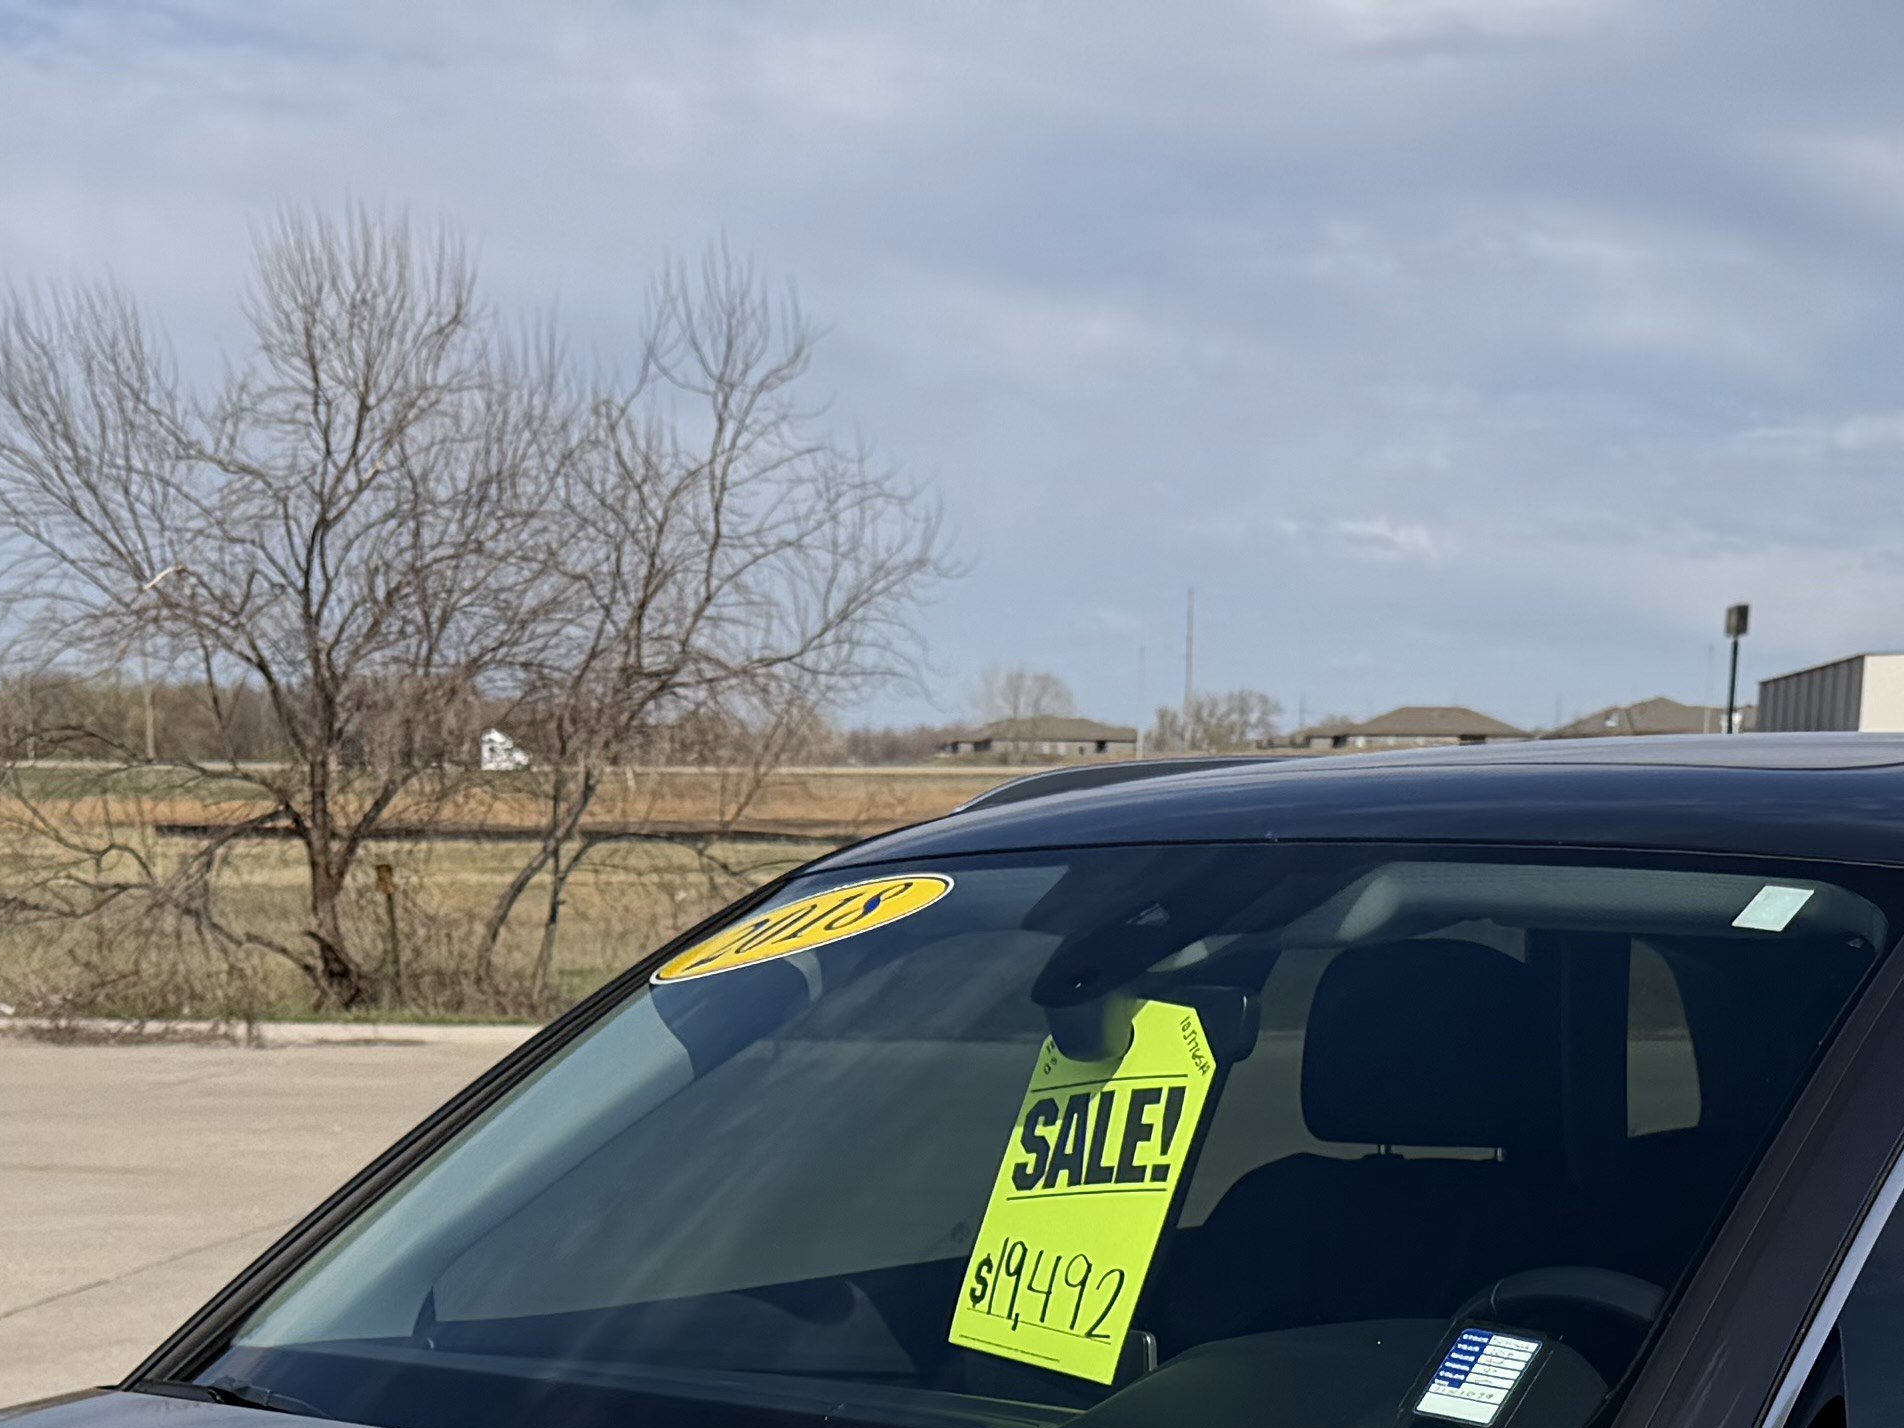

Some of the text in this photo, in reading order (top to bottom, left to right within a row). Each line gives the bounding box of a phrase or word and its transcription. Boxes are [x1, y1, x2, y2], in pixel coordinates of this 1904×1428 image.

[683, 881, 914, 972] 2018
[1010, 1085, 1187, 1191] SALE!
[969, 1236, 1126, 1340] $19,492
